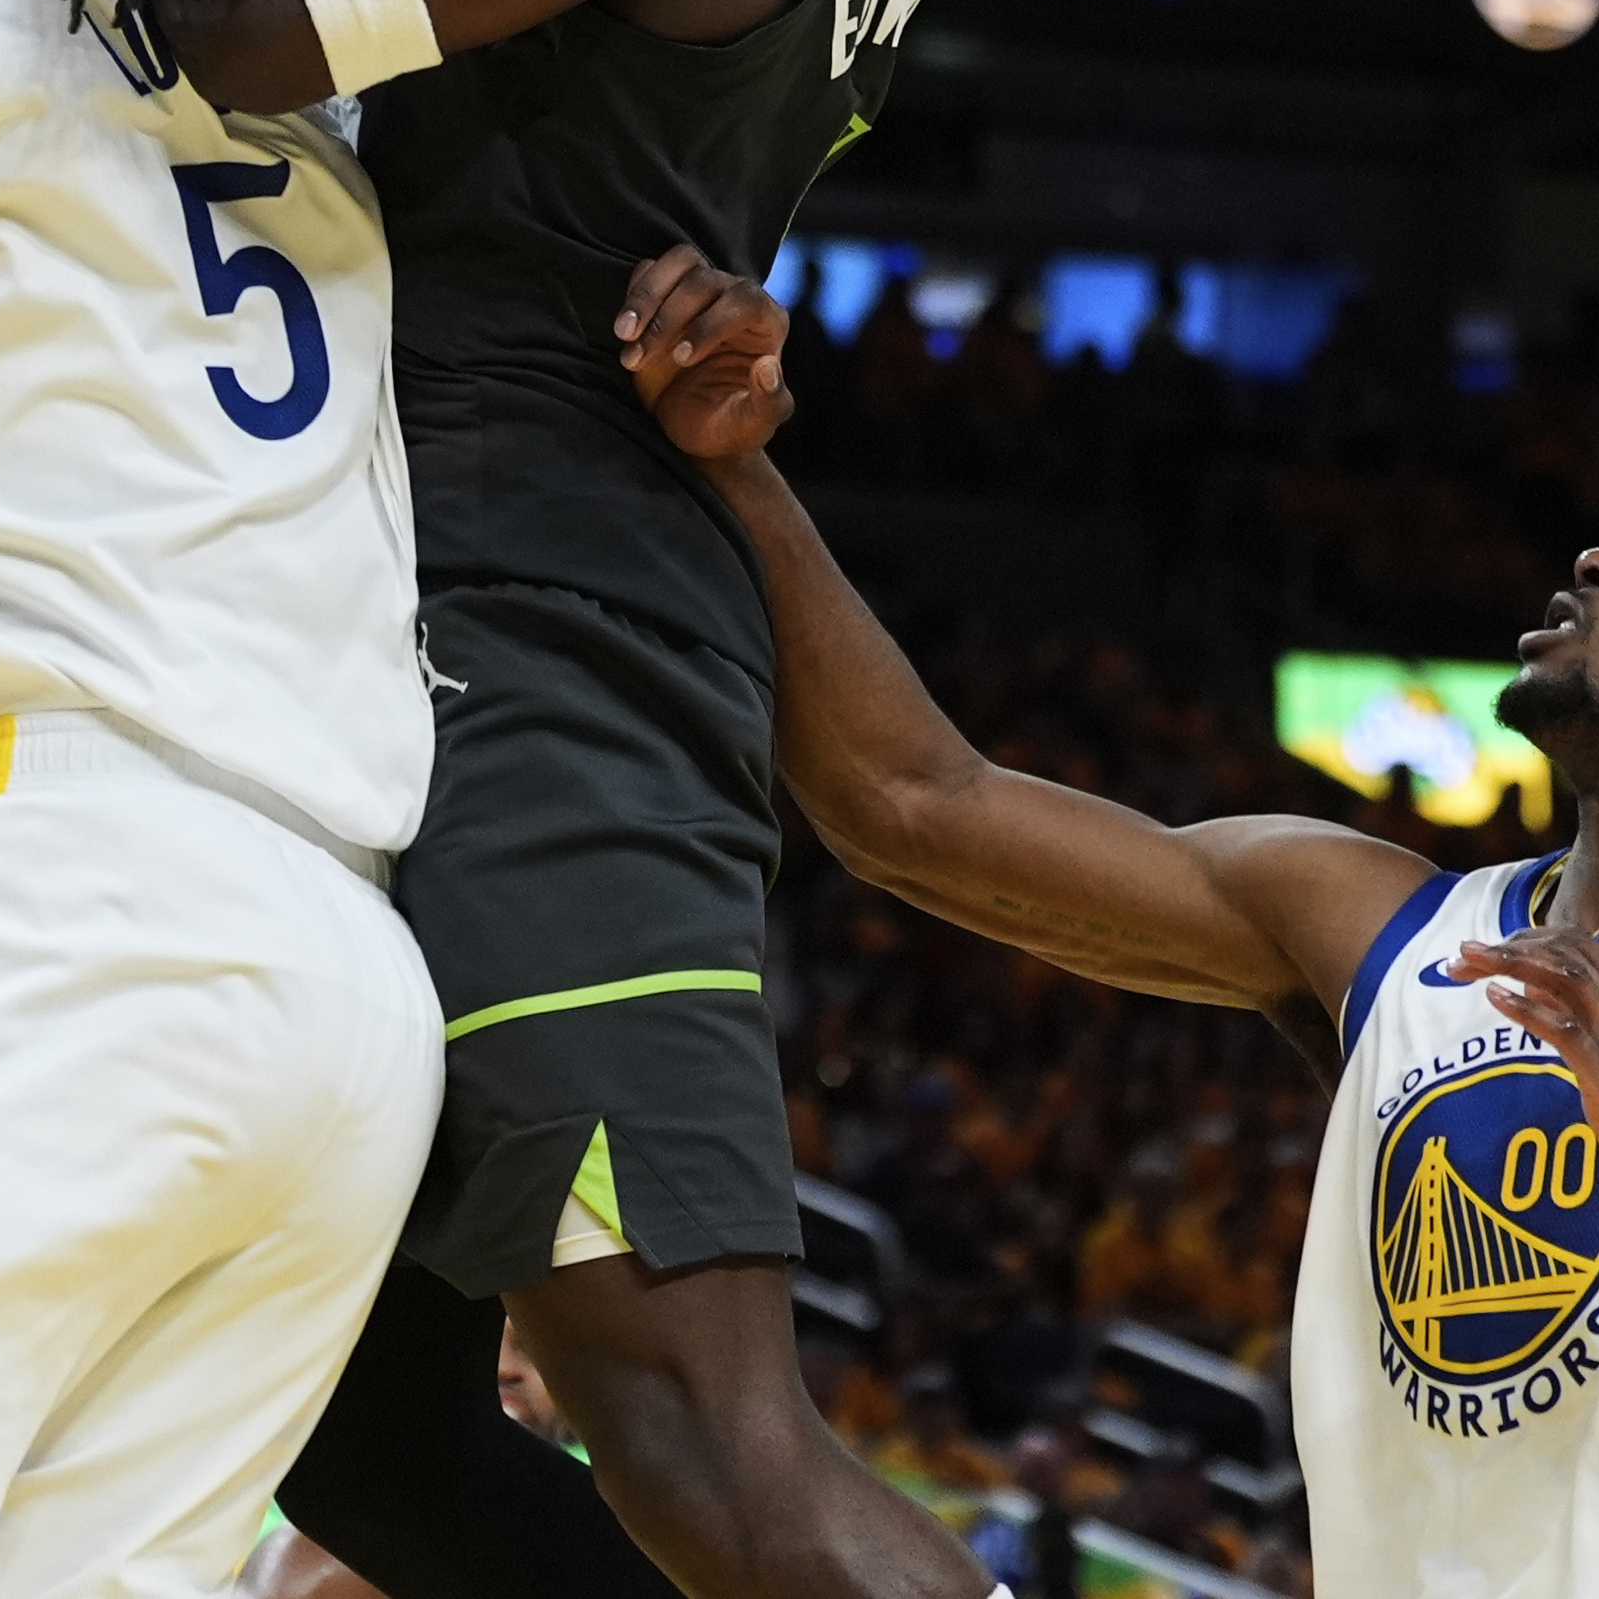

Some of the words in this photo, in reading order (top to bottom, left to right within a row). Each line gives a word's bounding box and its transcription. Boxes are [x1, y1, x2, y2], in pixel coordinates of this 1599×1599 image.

[170, 159, 330, 440] 5
[1377, 1027, 1542, 1120] GOLDEN
[1501, 1123, 1597, 1212] 00
